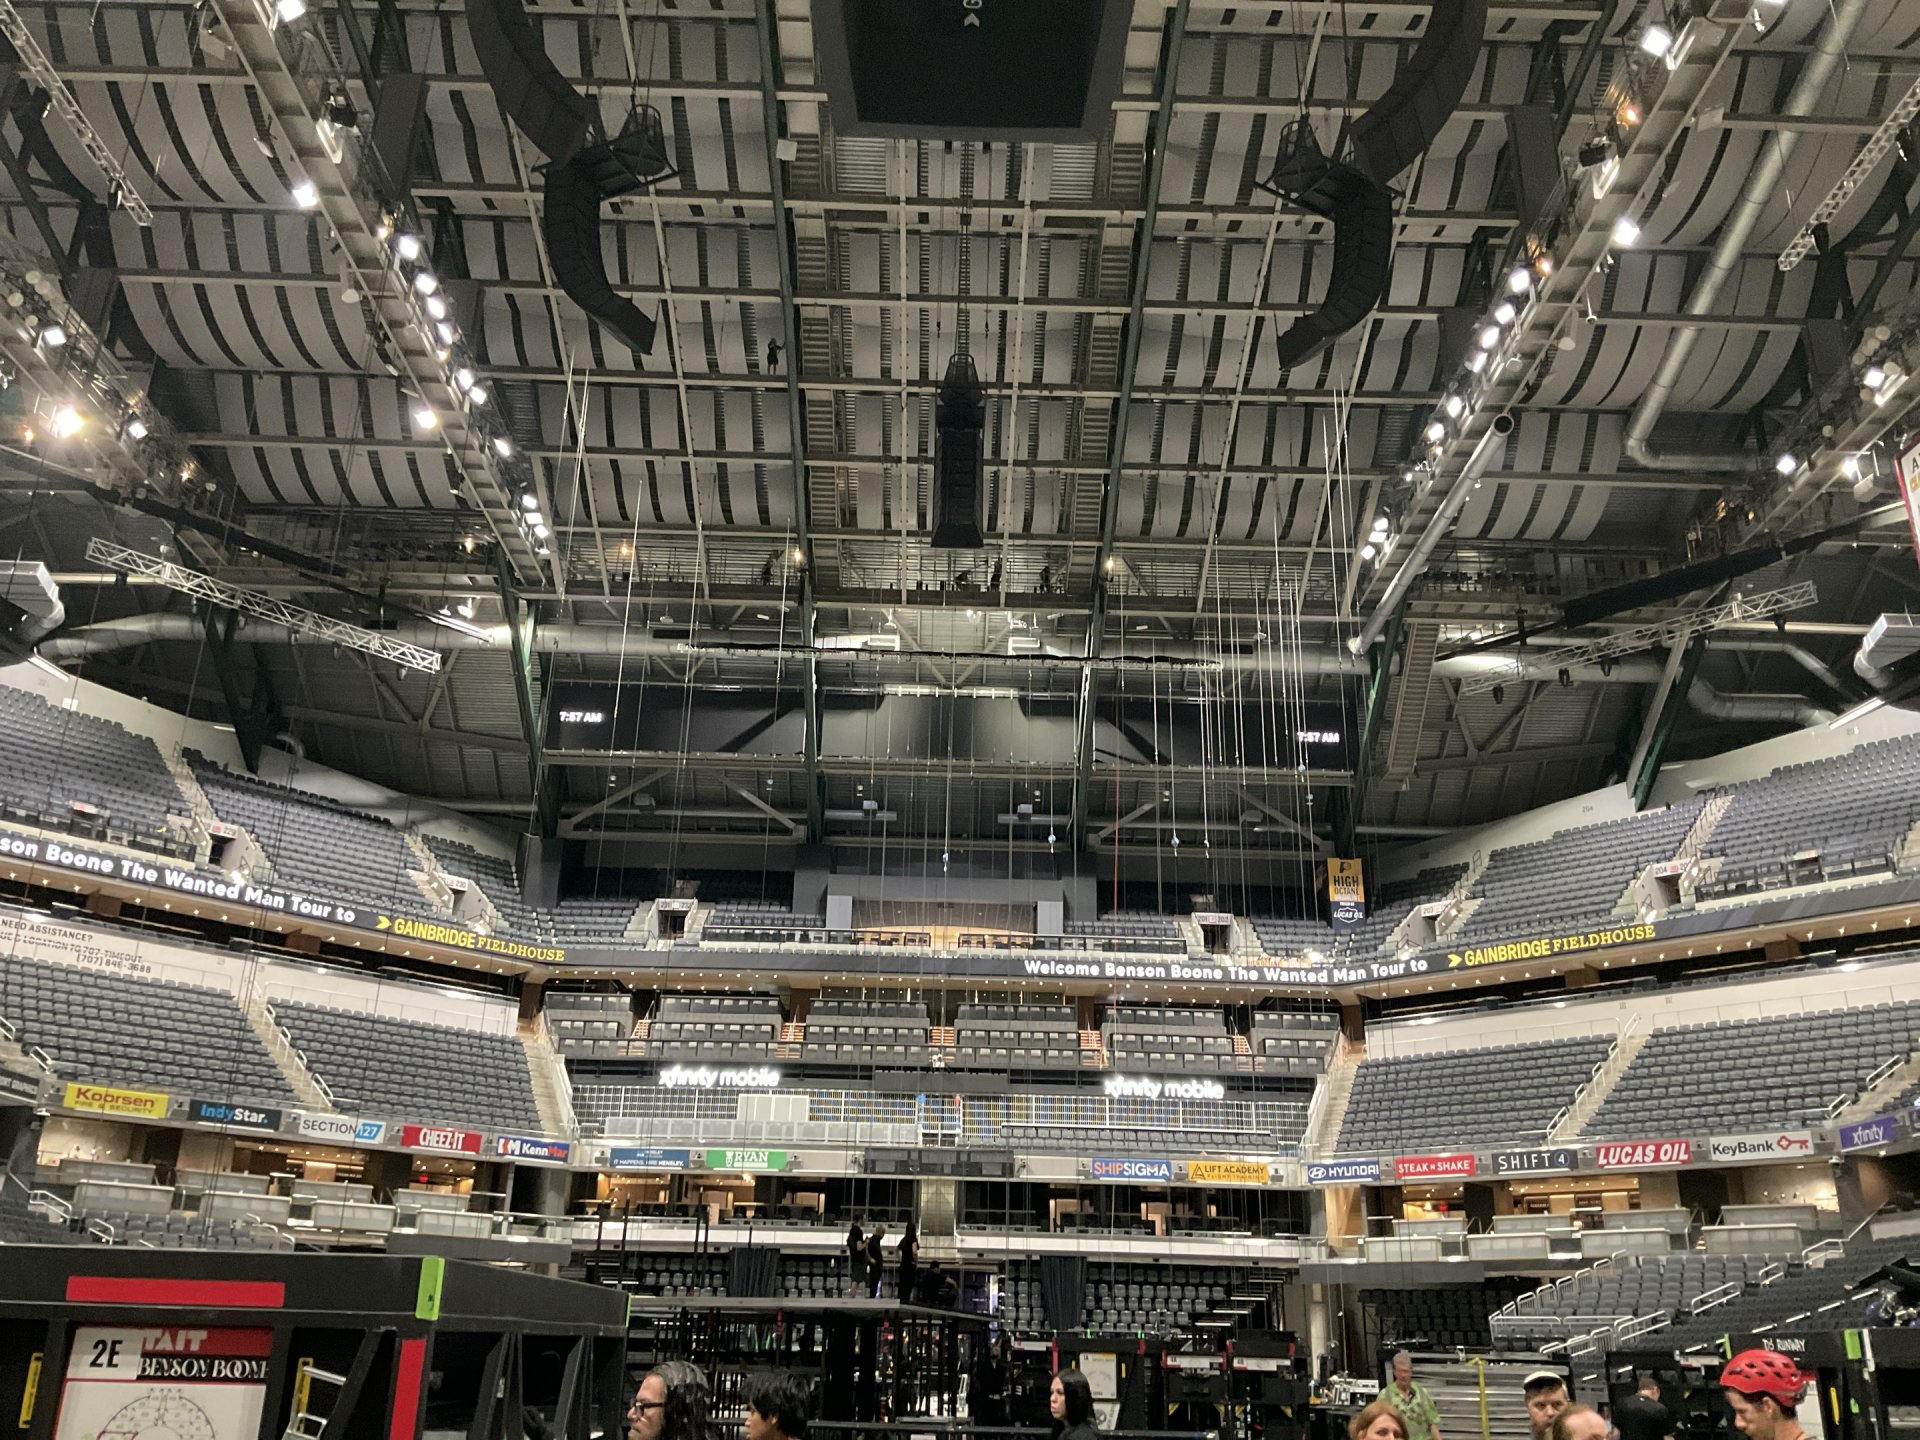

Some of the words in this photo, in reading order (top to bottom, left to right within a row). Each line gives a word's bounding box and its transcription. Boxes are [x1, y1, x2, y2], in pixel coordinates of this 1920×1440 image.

[559, 711, 583, 722] 7:57
[583, 711, 603, 722] AM
[1321, 732, 1340, 743] AM
[1655, 866, 1668, 875] 204
[45, 844, 114, 872] Boone
[121, 859, 158, 882] The
[165, 869, 240, 900] Wanted
[245, 886, 285, 909] Man
[291, 897, 332, 918] Tour
[336, 908, 356, 923] to
[1333, 875, 1359, 887] HIGH
[1334, 887, 1360, 895] OCTANE
[1333, 911, 1353, 919] LUCAS
[0, 919, 27, 931] NEED
[28, 924, 94, 943] ASSISTANCE?
[393, 918, 477, 948] GAINBRIDGE
[476, 935, 565, 962] FIELDHOUSE
[1464, 938, 1551, 966] GAINBRIDGE
[1552, 924, 1656, 952] FIELDHOUSE
[1024, 959, 1101, 977] Welcome
[1105, 962, 1166, 978] Benson
[1170, 964, 1223, 980] Boone
[1228, 966, 1259, 981] The
[1263, 967, 1328, 983] Wanted
[1333, 968, 1367, 984] Man
[1370, 961, 1406, 978] Tour
[1411, 959, 1429, 972] to
[658, 1065, 719, 1089] xfinity
[719, 1067, 780, 1087] mobile
[1104, 1075, 1162, 1100] xfinity
[1164, 1079, 1225, 1099] mobile
[76, 1087, 155, 1109] Koorsen
[74, 1100, 94, 1108] FIRE
[109, 1104, 153, 1114] SECURITY
[302, 1119, 357, 1135] SECTION
[1853, 1124, 1884, 1145] xfinity
[521, 1143, 568, 1158] KennMar
[1599, 1145, 1654, 1165] LUCAS
[1660, 1142, 1689, 1162] OIL
[1712, 1140, 1775, 1156] KeyBank
[734, 1151, 769, 1163] RYAN
[1498, 1152, 1551, 1170] SHIFT
[1557, 1153, 1566, 1165] 4
[1094, 1161, 1170, 1177] SHIPSIGMA
[1204, 1165, 1222, 1174] LIFT
[1223, 1165, 1265, 1174] ACADEMY
[1328, 1164, 1379, 1177] HYUNDAI
[1398, 1162, 1429, 1174] STEAK
[1437, 1160, 1470, 1171] SHAKE
[141, 1330, 208, 1350] TAIT
[89, 1339, 123, 1368] 2E
[137, 1357, 210, 1377] BENSON
